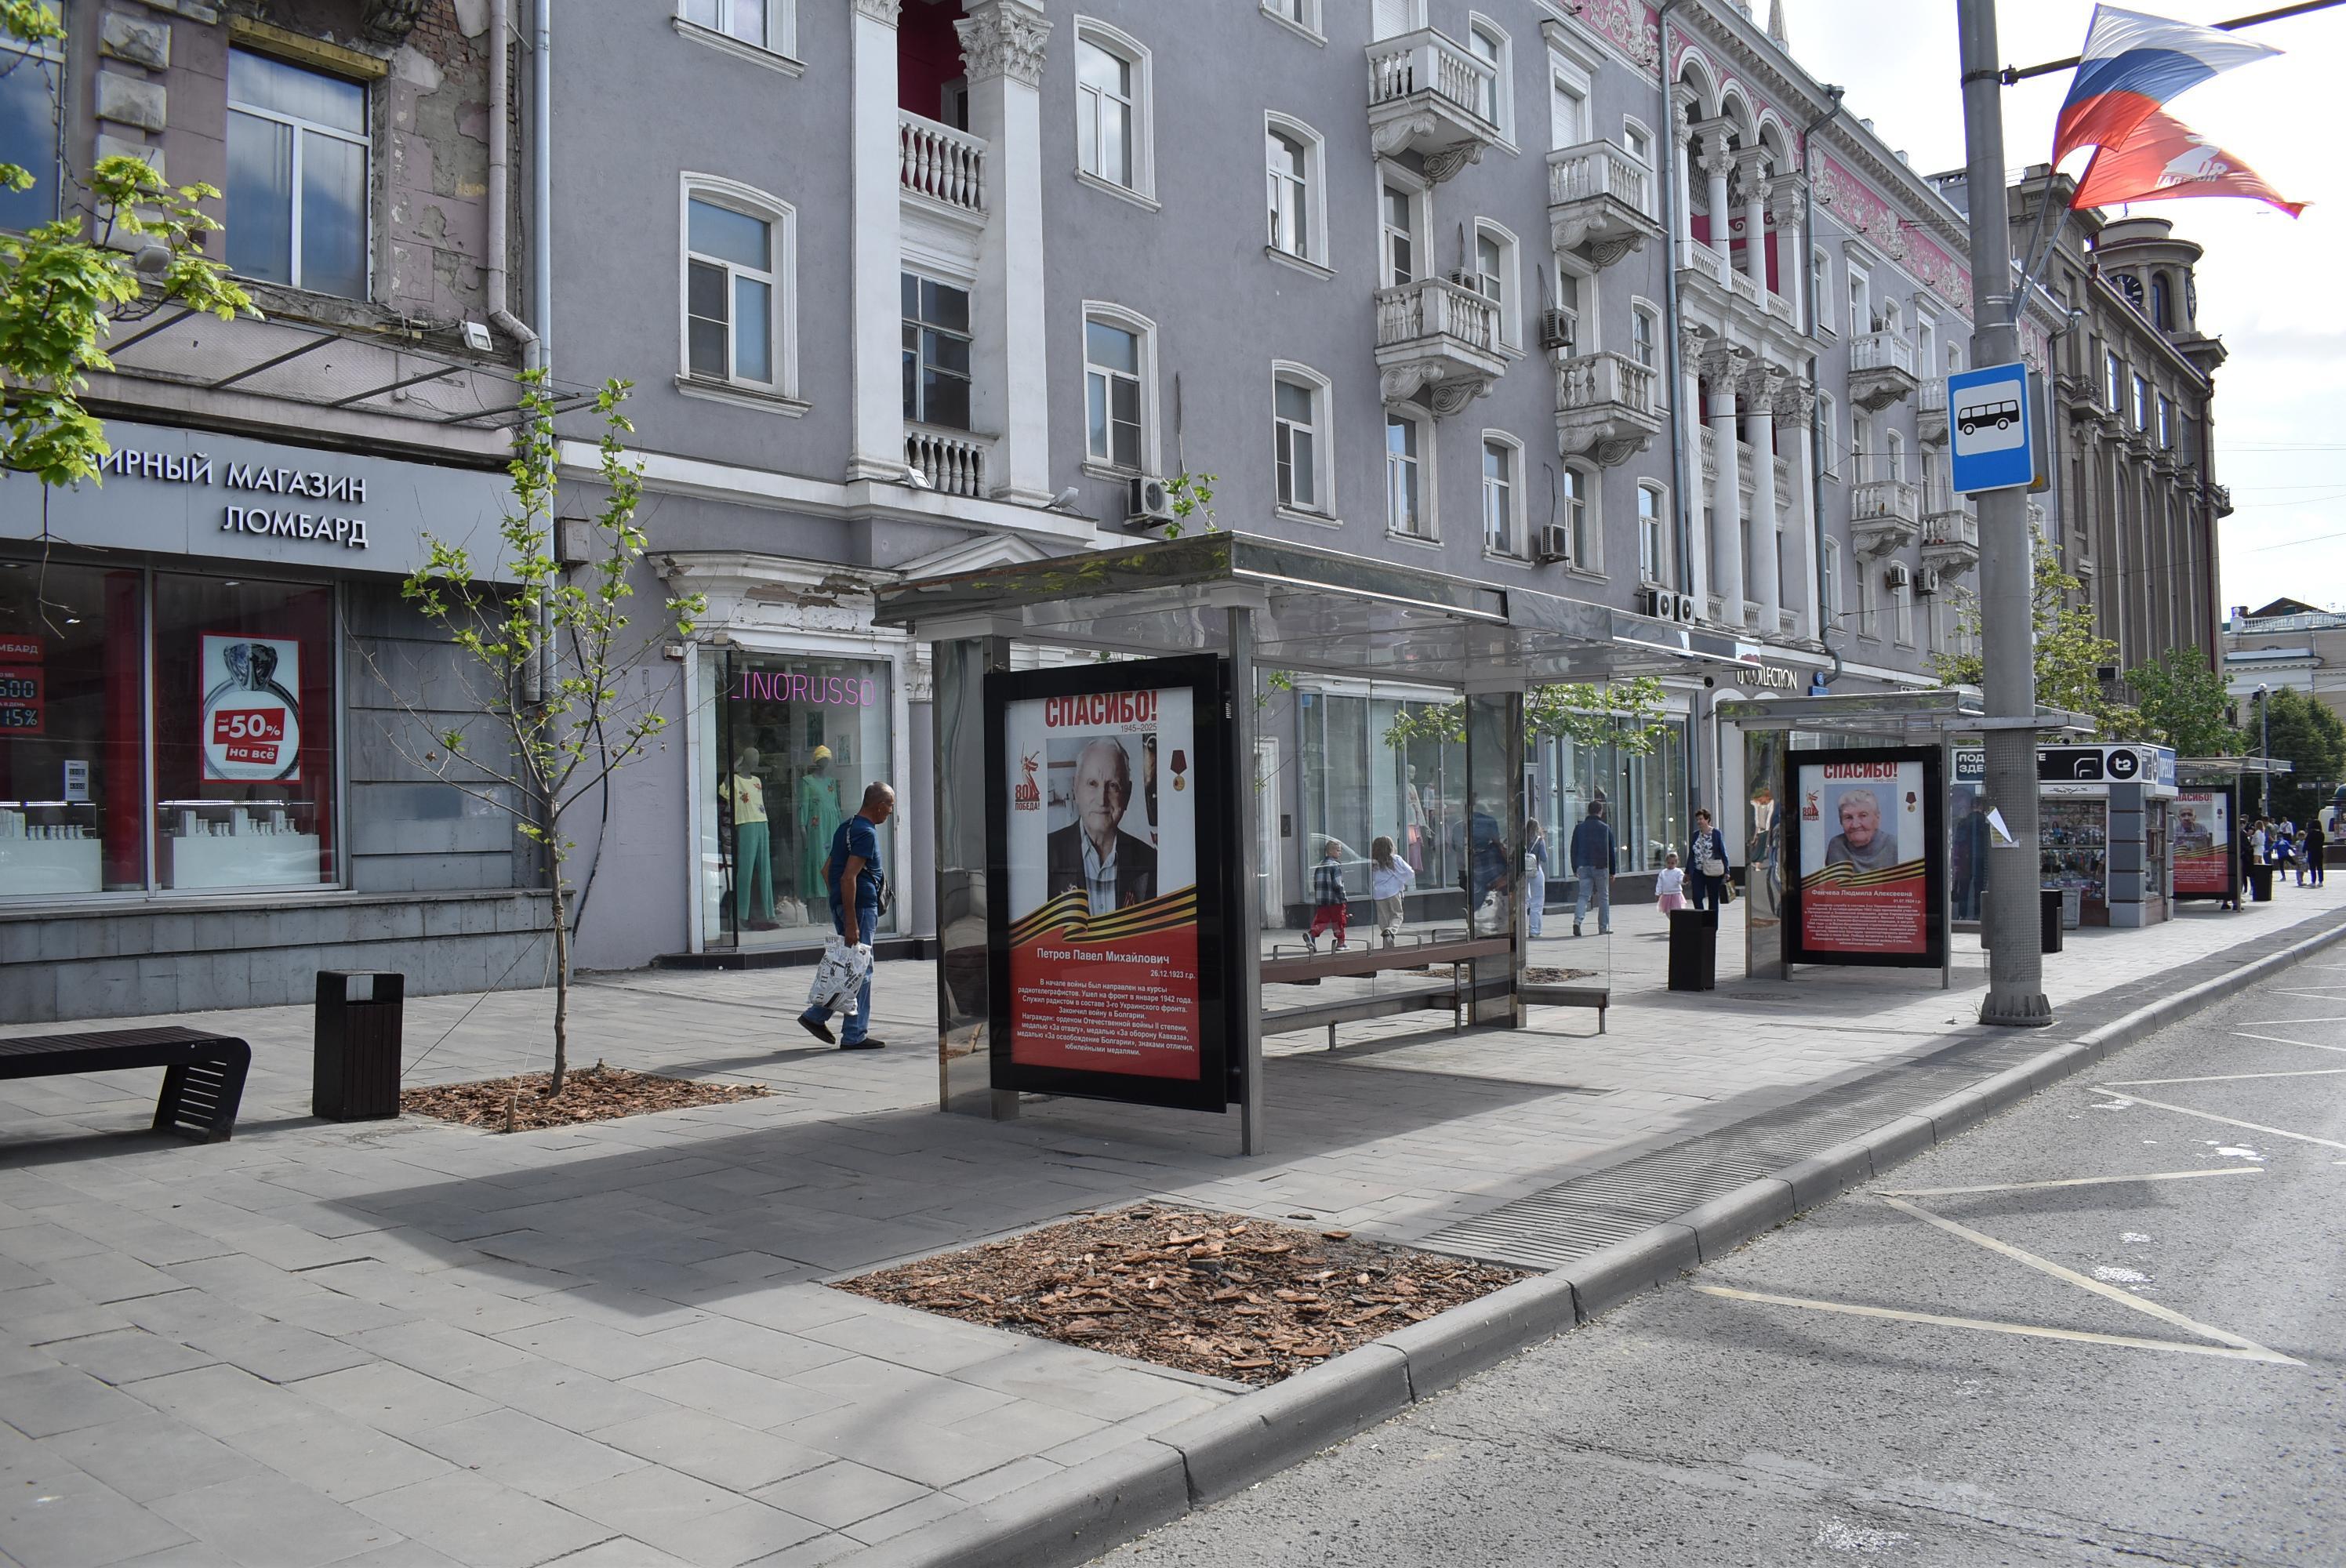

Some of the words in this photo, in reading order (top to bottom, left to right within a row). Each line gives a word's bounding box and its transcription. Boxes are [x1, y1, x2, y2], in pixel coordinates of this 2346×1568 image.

[226, 461, 366, 503] МАГАЗИН
[221, 505, 369, 549] ЛОМБАРД
[732, 671, 874, 706] INORUSSO
[1045, 690, 1158, 728] СПАСИБО!
[218, 714, 281, 738] -50%
[229, 748, 248, 757] на
[252, 747, 275, 760] всё
[1824, 762, 1898, 779] СПАСИБО!
[2115, 758, 2131, 771] t2
[1015, 784, 1030, 800] 80
[2174, 793, 2212, 802] ПАСИБО!
[1015, 801, 1040, 811] ПОБЕДА!
[1037, 948, 1071, 961] Петров
[1073, 949, 1102, 961] Павел
[1106, 951, 1170, 964] Михайлович
[1150, 970, 1183, 978] 26.12.1923
[1018, 987, 1080, 997] радиотелеграфистов.
[1120, 1002, 1159, 1011] Украинского
[1088, 1009, 1107, 1018] войну
[1113, 1011, 1146, 1019] Болгарии.
[1022, 1012, 1055, 1022] Награжден:
[1084, 1018, 1130, 1027] Отечественной
[1160, 1024, 1188, 1033] степени,
[1056, 1034, 1099, 1043] освобождение
[1101, 1036, 1137, 1047] Болгарии»,
[1129, 1030, 1157, 1040] оборону
[1158, 1032, 1189, 1041] Кавказа»,
[1065, 1044, 1106, 1052] юбилейными
